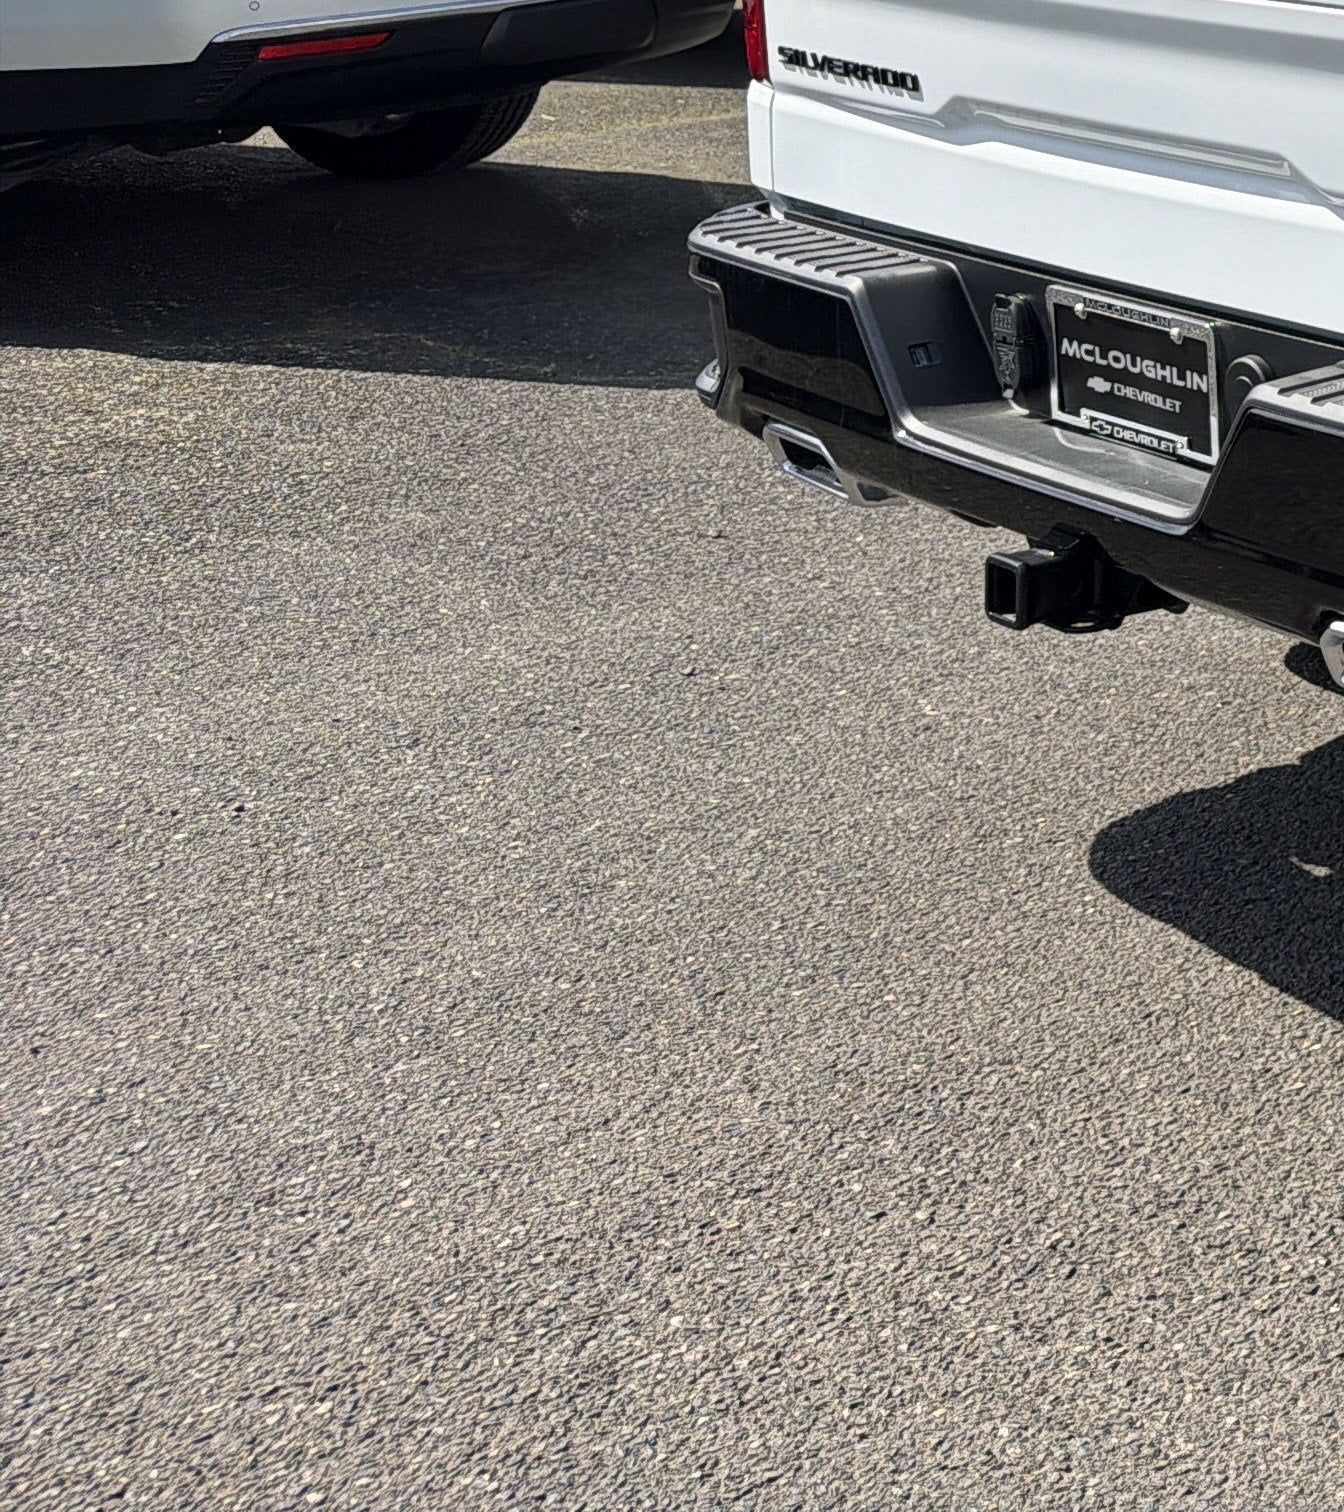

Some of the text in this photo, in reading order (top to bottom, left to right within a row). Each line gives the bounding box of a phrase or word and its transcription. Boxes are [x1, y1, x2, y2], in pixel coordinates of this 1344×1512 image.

[777, 45, 921, 92] SILVERADO
[1086, 299, 1171, 328] MCLOUGHLIN
[1061, 337, 1208, 393] MCLOUGHLIN
[1113, 382, 1183, 414] CHEVROLET
[1113, 426, 1175, 454] CHEVROLET
